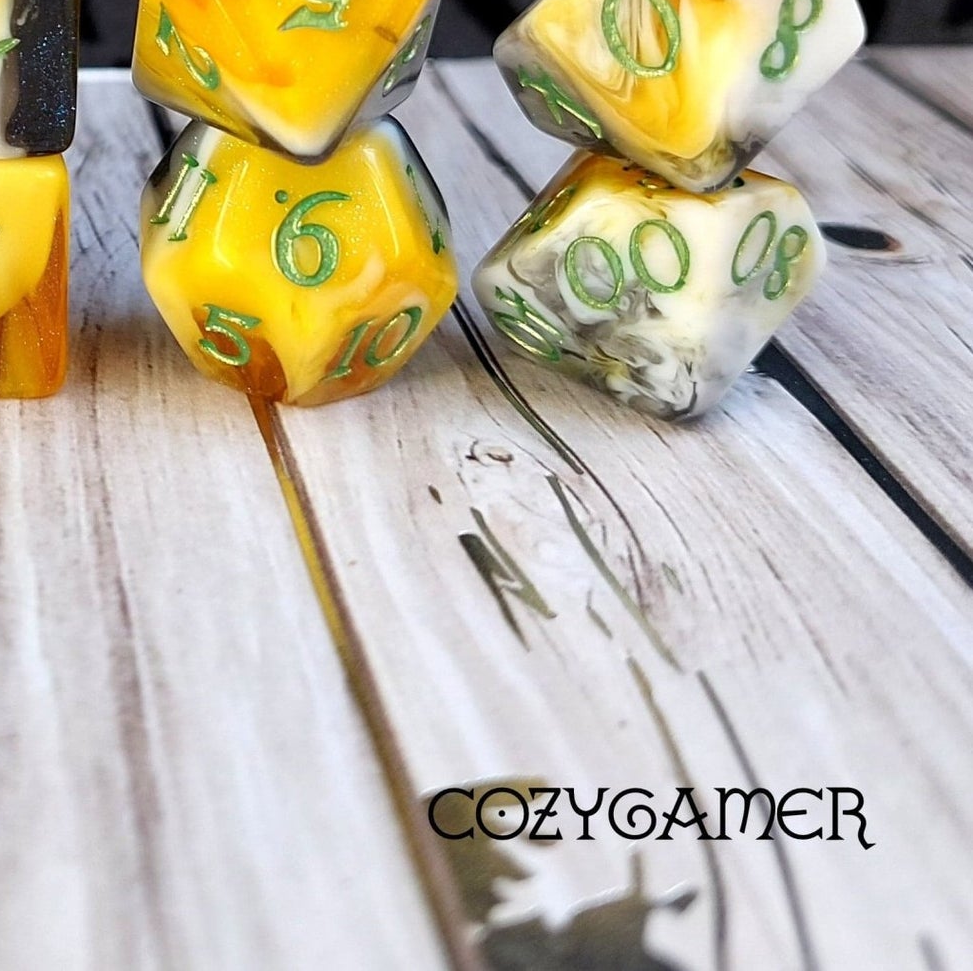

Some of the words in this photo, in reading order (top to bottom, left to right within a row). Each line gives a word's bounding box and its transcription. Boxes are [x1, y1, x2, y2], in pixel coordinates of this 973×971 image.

[149, 153, 218, 242] 11
[564, 218, 692, 312] 00
[197, 303, 263, 367] 5
[321, 305, 423, 381] 10
